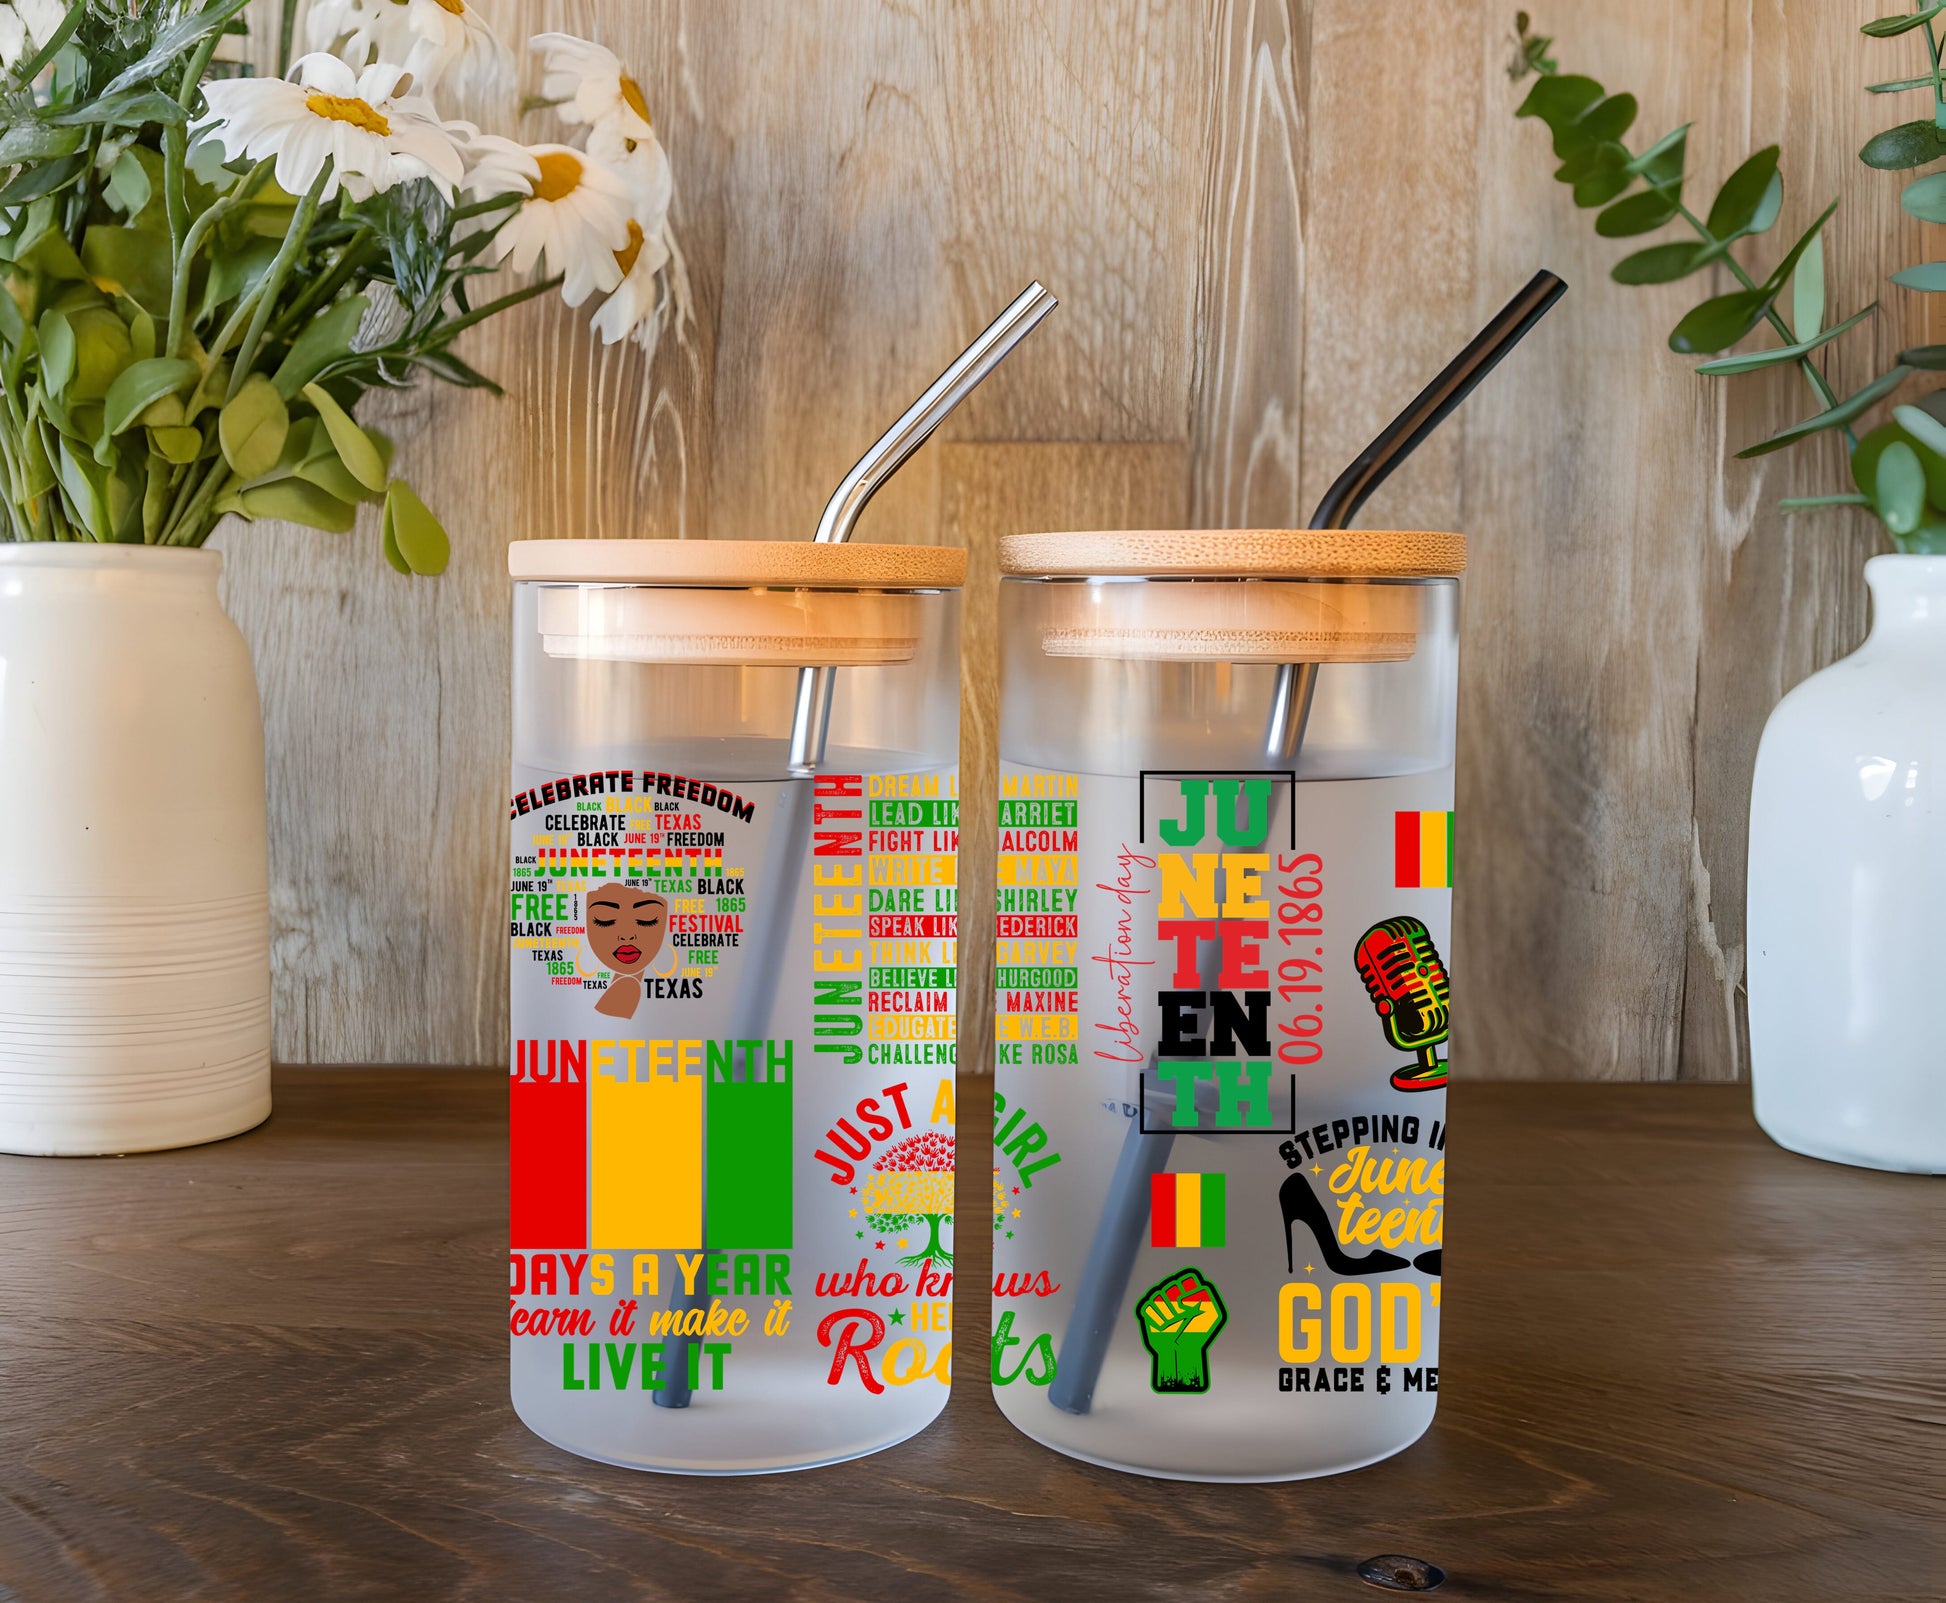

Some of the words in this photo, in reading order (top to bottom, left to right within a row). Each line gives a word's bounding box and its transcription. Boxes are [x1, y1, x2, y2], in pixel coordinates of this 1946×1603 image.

[869, 775, 939, 797] DREAM
[1002, 775, 1078, 797] MARTIN
[576, 802, 602, 811] BLACK
[605, 796, 652, 813] BLACK
[654, 802, 680, 811] BLACK
[643, 771, 756, 824] FREEDOM
[545, 815, 626, 831] CELEBRATE
[629, 819, 651, 831] FREE
[655, 813, 702, 830] TEXAS
[871, 802, 923, 826] LEAD
[933, 802, 959, 826] LIK
[1001, 802, 1075, 826] ARRIET
[1159, 780, 1272, 847] JU
[577, 832, 619, 847] BLACK
[624, 833, 646, 844] JUNE
[667, 832, 724, 847] FREEDOM
[869, 830, 924, 852] FIGHT
[933, 830, 958, 852] LIK
[999, 830, 1078, 852] ALCOLM
[513, 867, 532, 877] 1865
[515, 856, 536, 864] BLACK
[534, 848, 722, 877] JUNETEENTH
[726, 867, 745, 877] 1865
[871, 857, 943, 883] WRITE
[1016, 857, 1074, 883] MAYA
[1096, 843, 1156, 905] day
[511, 880, 533, 892] JUNE
[556, 880, 587, 892] TEXAS
[624, 879, 640, 887] JUNE
[654, 879, 693, 893] TEXAS
[697, 879, 744, 895] BLACK
[1157, 853, 1270, 918] NE
[511, 894, 569, 921] FREE
[674, 898, 705, 914] FREE
[716, 897, 746, 913] 1865
[869, 888, 924, 912] DARE
[511, 922, 552, 937] BLACK
[556, 926, 586, 935] FREEDOM
[669, 914, 744, 933] FESTIVAL
[814, 775, 863, 1064] JUNETEENTH
[870, 916, 925, 937] SPEAK
[933, 916, 957, 937] LIK
[998, 916, 1076, 937] EDERICK
[513, 937, 579, 949] JUNETEENTH
[672, 933, 739, 947] CELEBRATE
[532, 950, 563, 961] TEXAS
[688, 950, 719, 965] FREE
[869, 941, 931, 964] THINK
[996, 941, 1078, 964] GARVEY
[1157, 920, 1269, 989] TE
[1278, 853, 1323, 1064] 06.19.1865
[547, 961, 574, 976] 1865
[681, 967, 701, 977] JUNE
[871, 968, 937, 987] BELIEVE
[997, 968, 1076, 987] HURGOOD
[551, 977, 582, 986] FREEDOM
[583, 980, 608, 990] TEXAS
[644, 978, 703, 999] TEXAS
[1091, 907, 1155, 1064] liberation
[868, 991, 948, 1012] RECLAIM
[1006, 991, 1078, 1012] MAXINE
[1020, 1017, 1076, 1038] W.E.B.
[1157, 991, 1271, 1056] EN
[868, 1043, 956, 1065] CHALLENG
[1031, 1043, 1078, 1065] ROSA
[1157, 1061, 1272, 1127] TH
[814, 1082, 912, 1185] JUST
[1278, 1114, 1420, 1170] STEPPING
[633, 1254, 658, 1296] A
[675, 1254, 792, 1296] YEAR
[815, 1258, 909, 1297] who
[609, 1299, 638, 1336] it
[649, 1299, 750, 1337] make
[764, 1299, 793, 1336] it
[910, 1302, 953, 1332] HE
[1278, 1282, 1441, 1364] GOD'
[563, 1343, 666, 1390] LIVE
[688, 1343, 732, 1390] IT
[1278, 1367, 1365, 1393] GRACE
